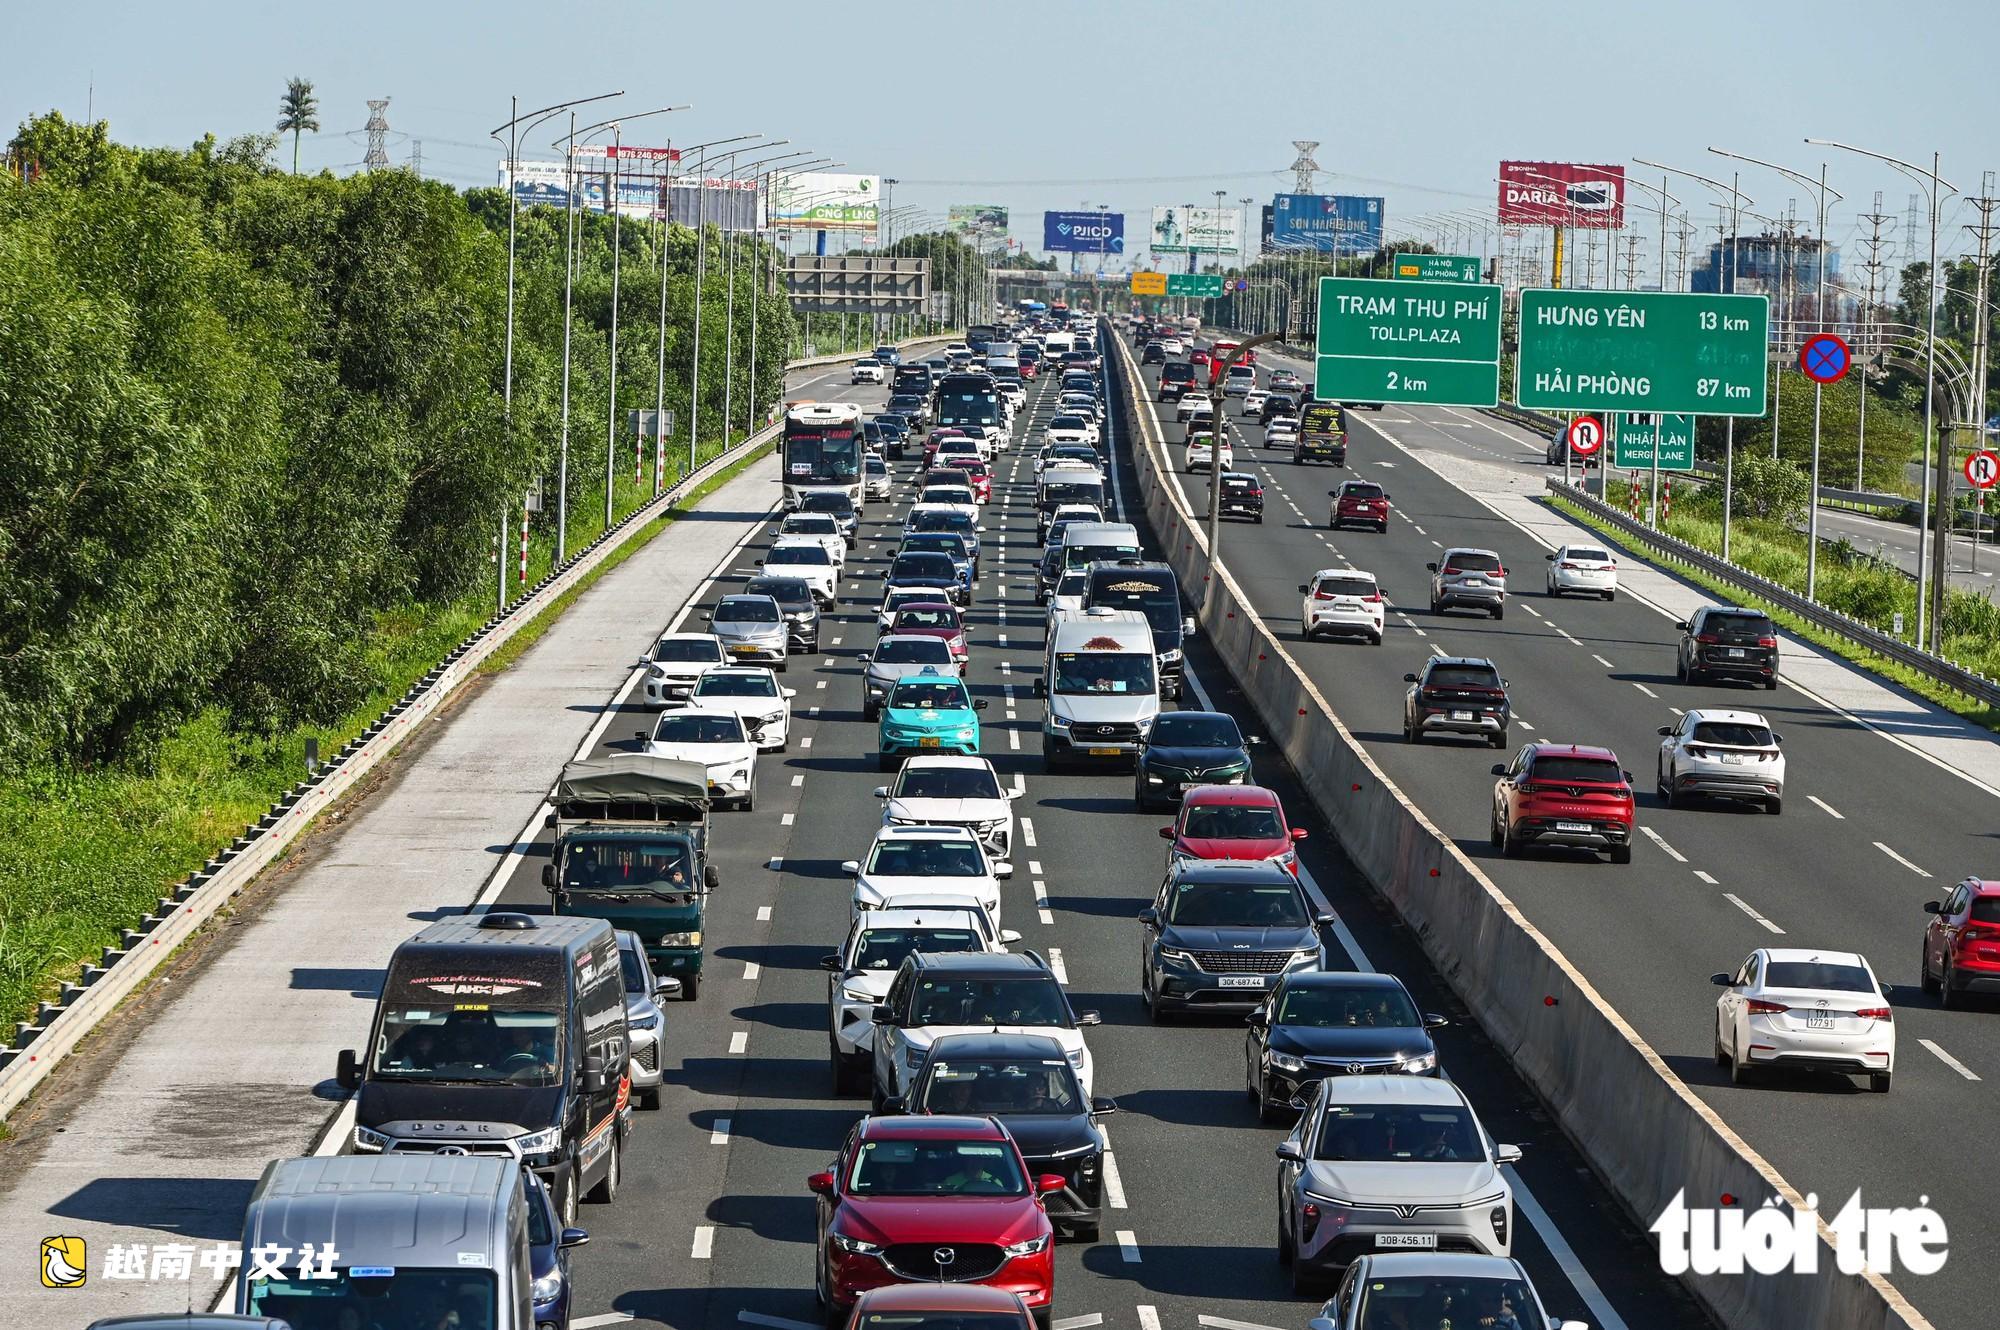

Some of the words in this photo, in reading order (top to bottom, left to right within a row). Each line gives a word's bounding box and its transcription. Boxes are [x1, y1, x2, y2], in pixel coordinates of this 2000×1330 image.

[1507, 189, 1559, 204] DARIA
[816, 208, 842, 219] CNG
[852, 210, 875, 220] LNG
[1073, 225, 1112, 238] PJICO
[1337, 296, 1396, 320] TRẠM
[1404, 299, 1446, 318] THU
[1453, 296, 1490, 321] PHÍ
[1537, 306, 1599, 326] HƯNG
[1604, 304, 1646, 328] YÊN
[1699, 312, 1718, 330] 13
[1724, 315, 1749, 331] km
[1370, 327, 1461, 344] TOLLPLAZA
[1387, 372, 1398, 390] 2
[1404, 377, 1427, 391] km
[1535, 367, 1571, 393] HẢI
[1577, 370, 1651, 396] PHÒNG
[1697, 379, 1720, 397] 87
[1725, 383, 1751, 398] km
[1660, 432, 1686, 446] LÀN
[1659, 451, 1685, 461] LANE
[411, 1123, 489, 1133] DCAR
[1380, 1235, 1431, 1245] 30B-456.11
